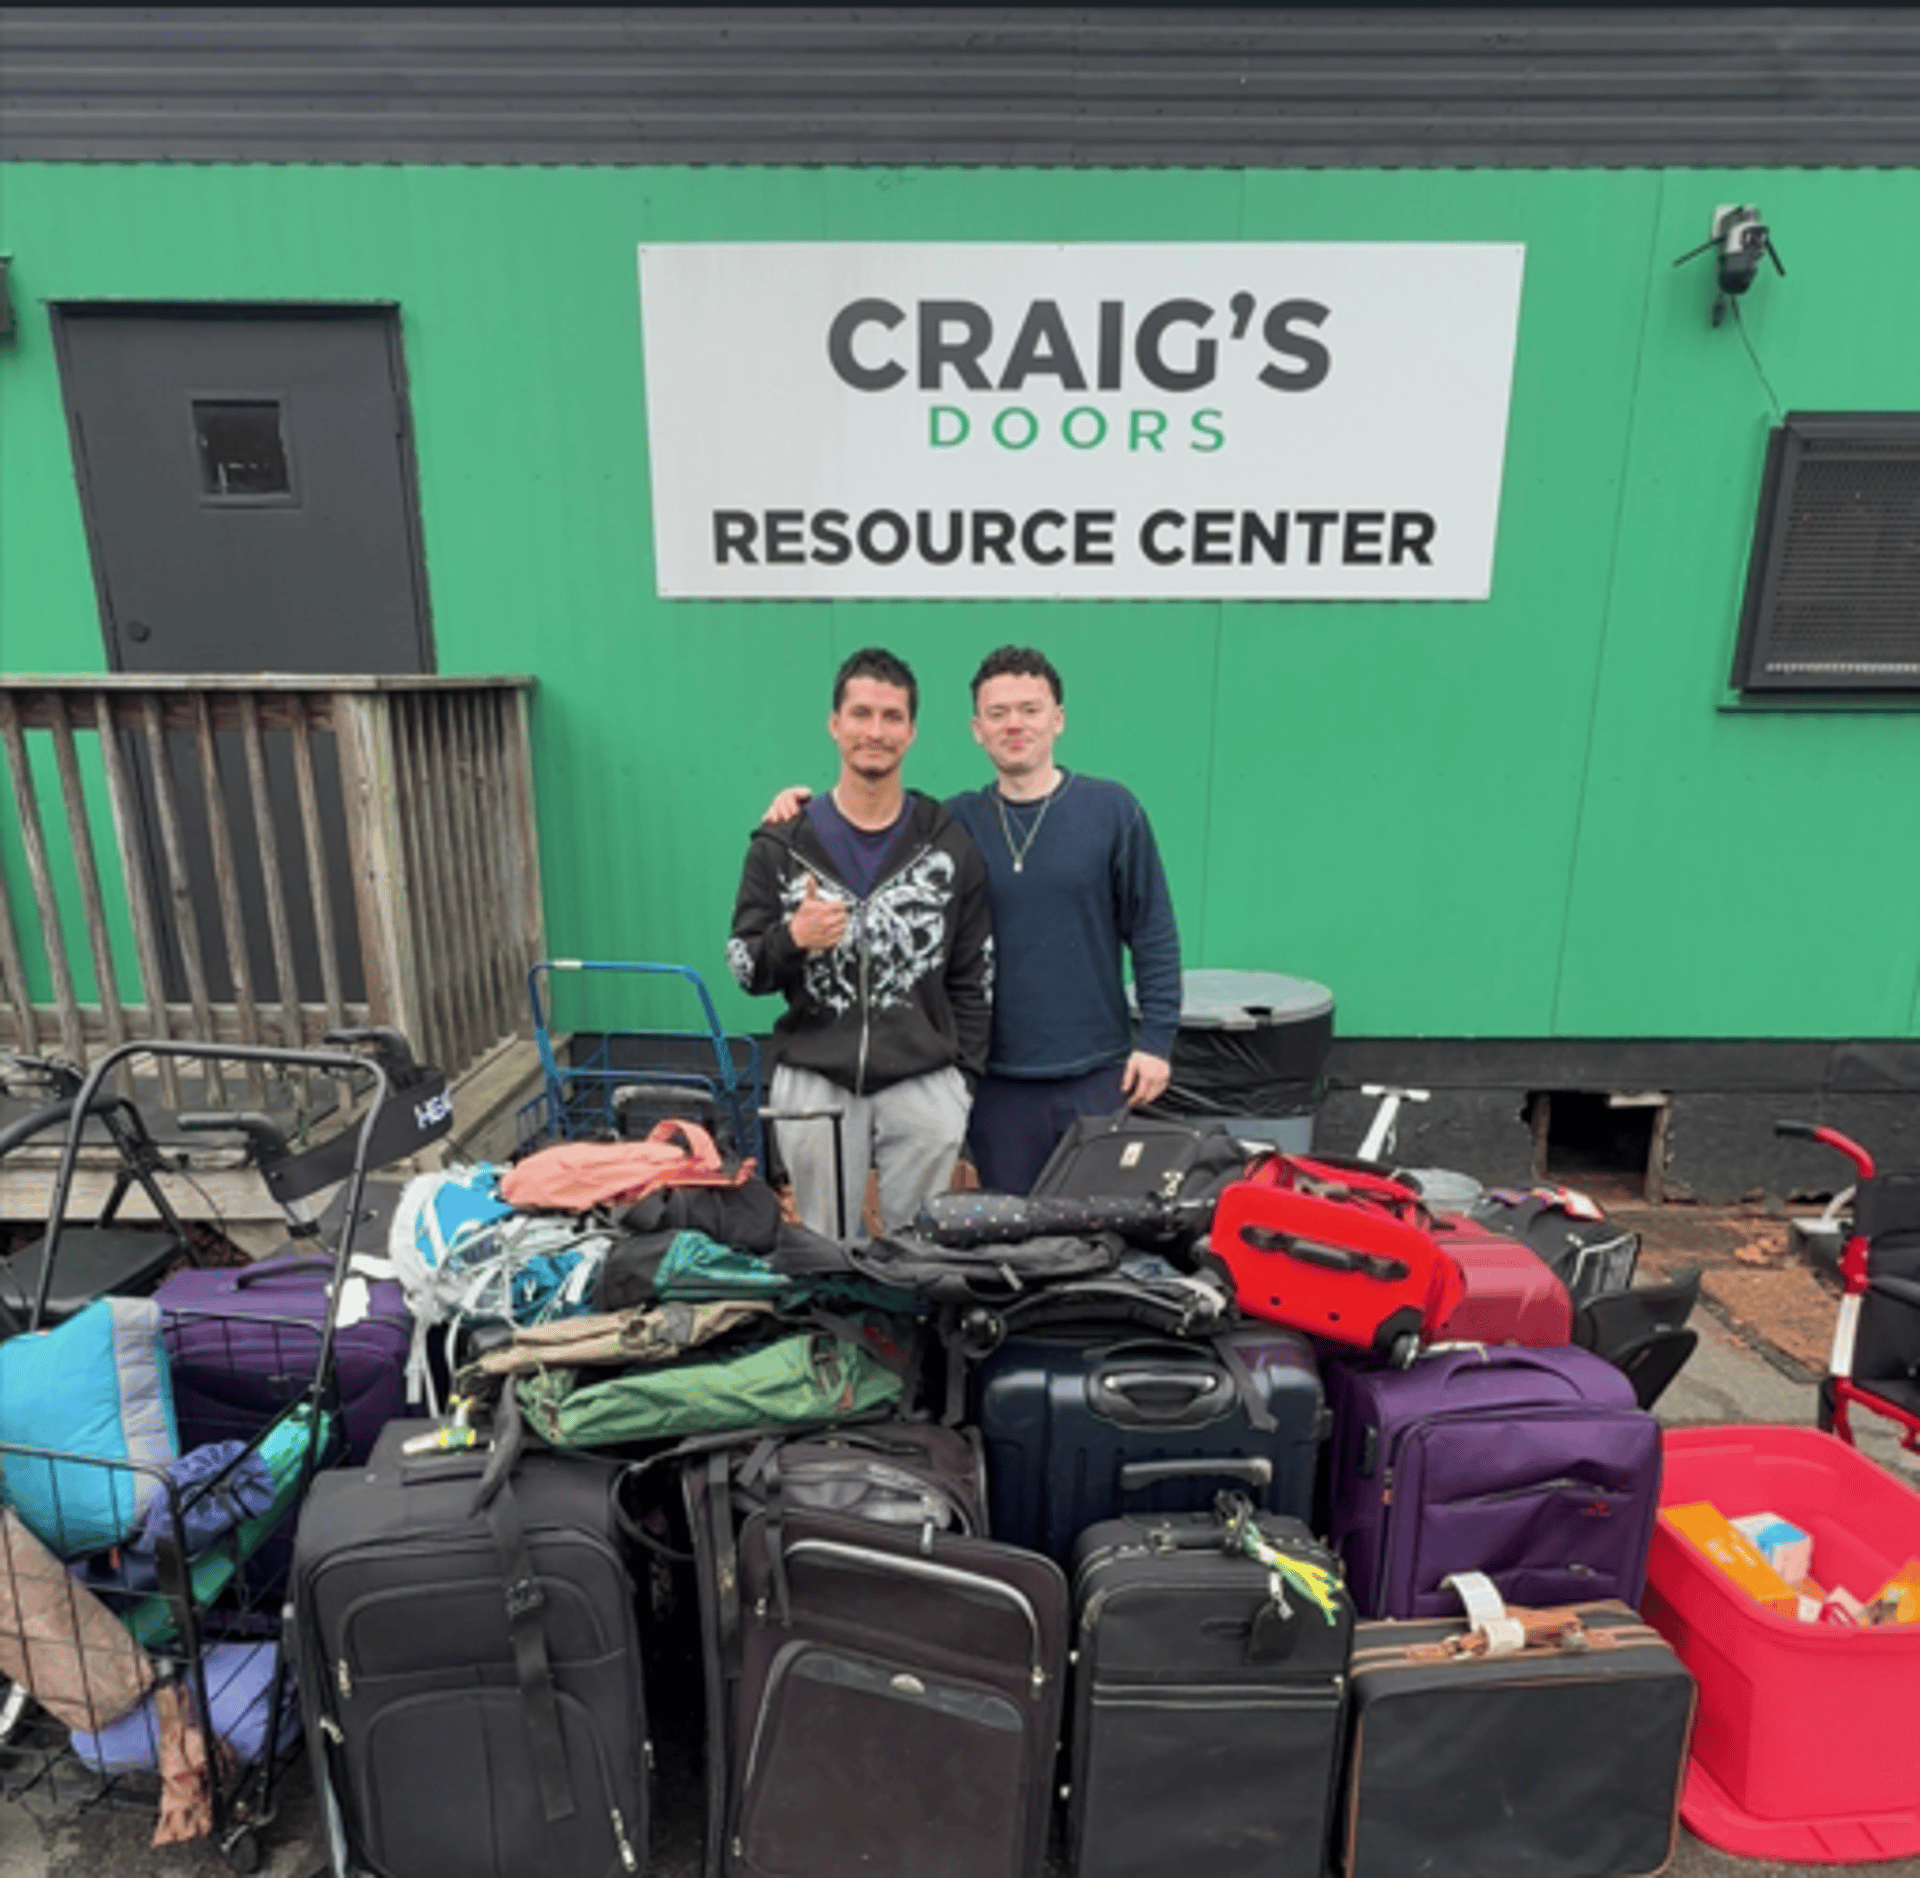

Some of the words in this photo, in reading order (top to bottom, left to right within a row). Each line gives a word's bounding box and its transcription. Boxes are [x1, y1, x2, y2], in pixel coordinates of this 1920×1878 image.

[827, 291, 1331, 393] CRAIG'S
[929, 406, 1225, 451] DOORS
[712, 508, 1116, 566] RESOURCE
[1138, 509, 1437, 566] CENTER
